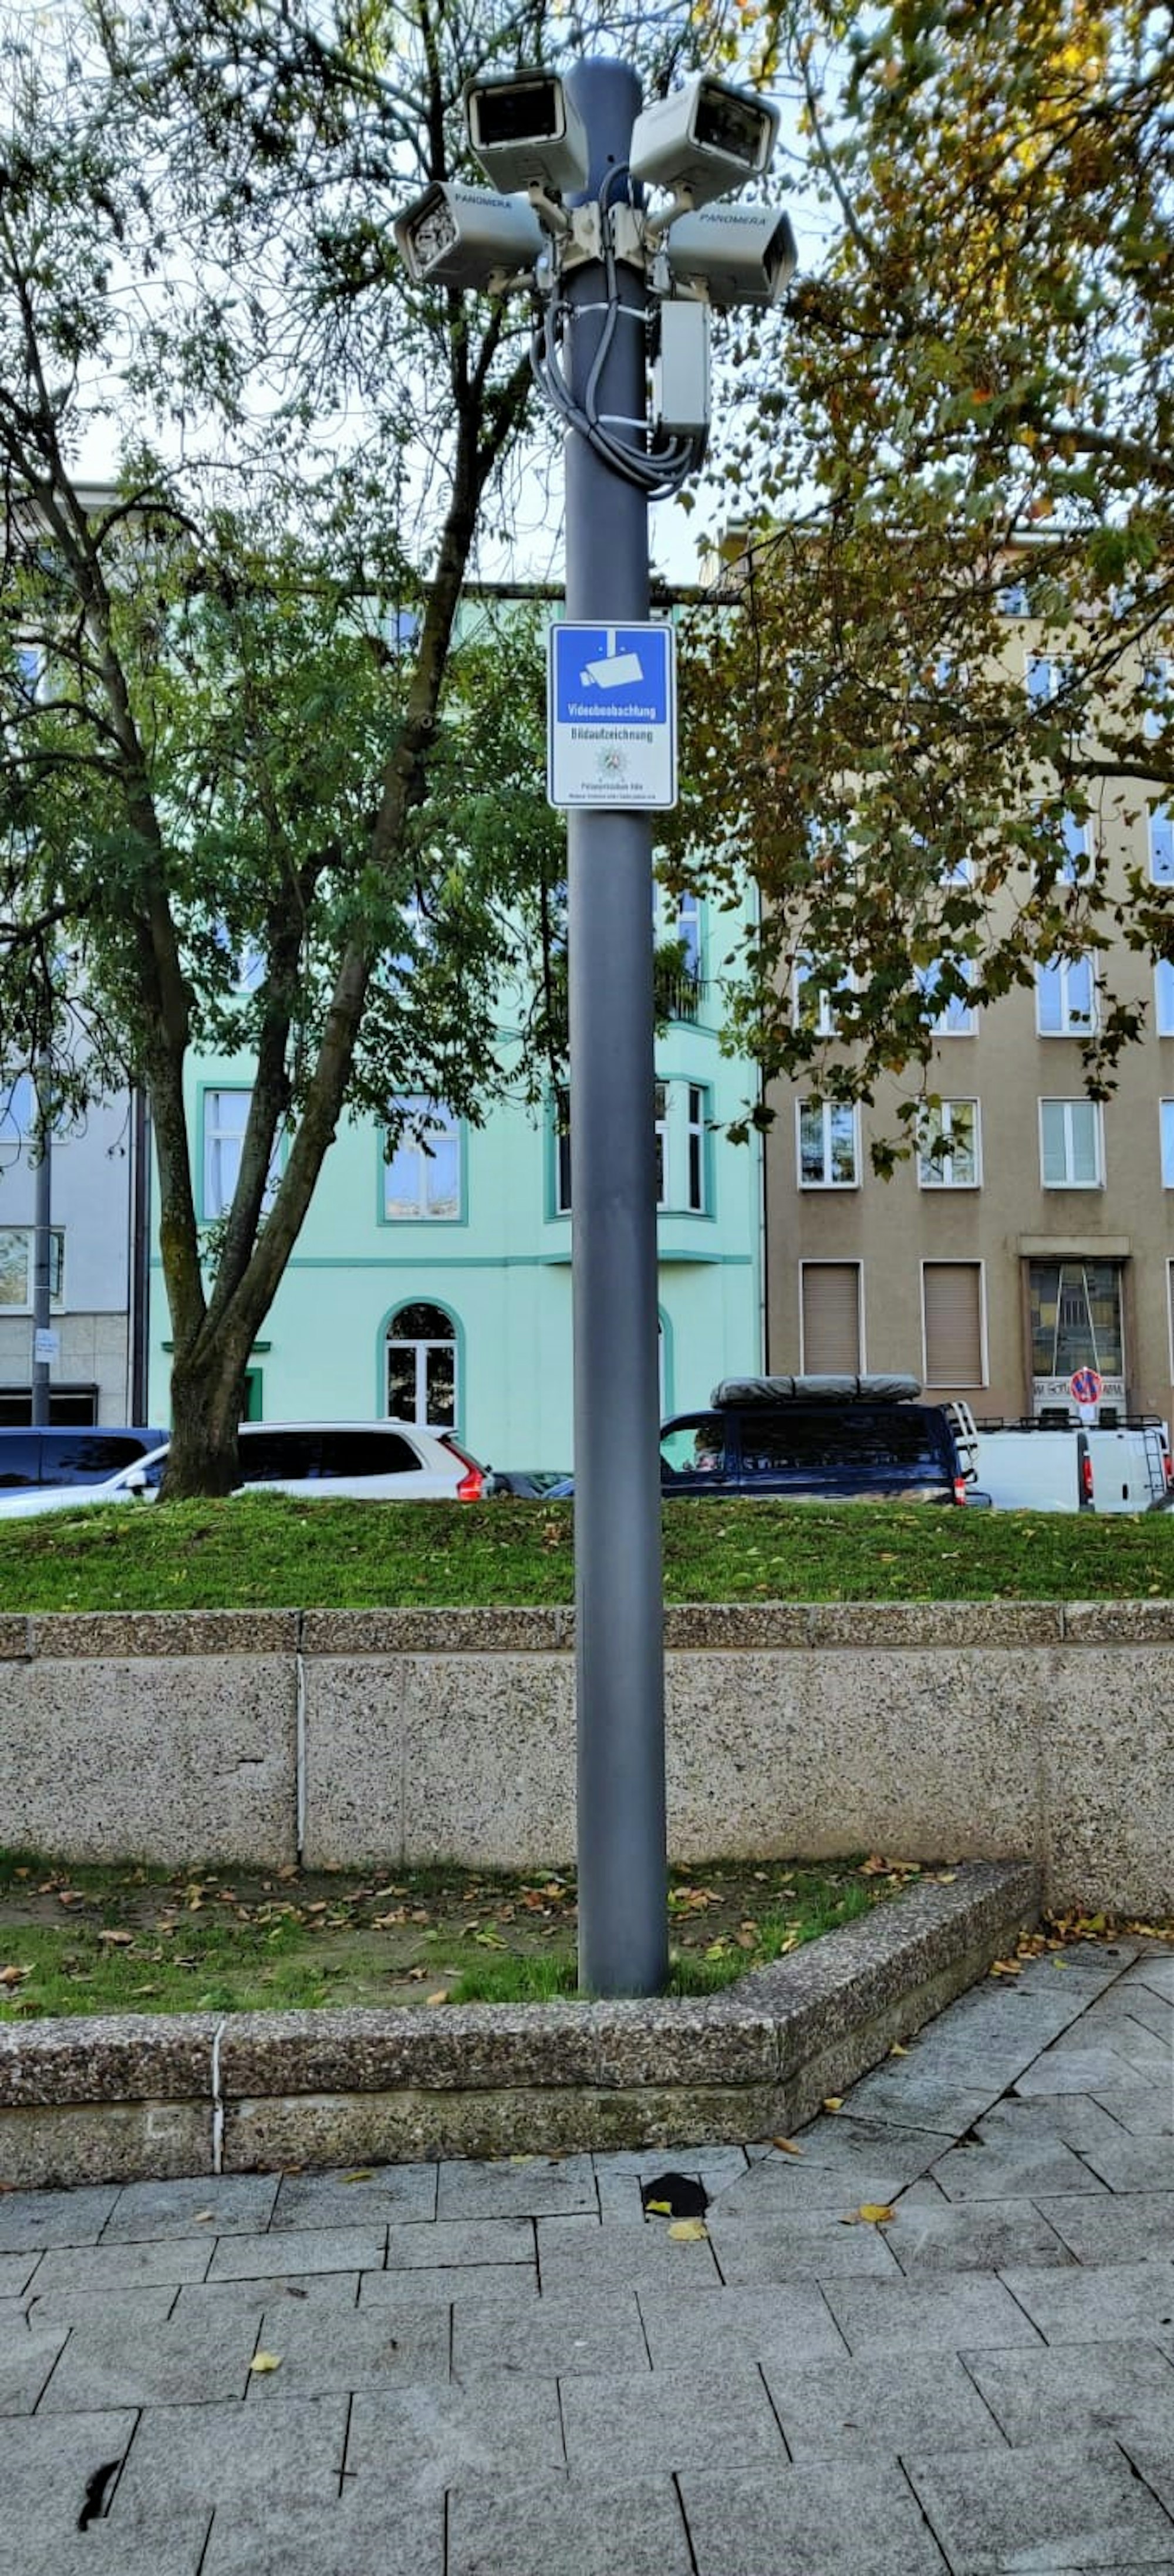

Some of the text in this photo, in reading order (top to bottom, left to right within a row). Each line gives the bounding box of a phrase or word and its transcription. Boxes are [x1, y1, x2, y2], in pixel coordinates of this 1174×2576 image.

[455, 193, 512, 208] PANOMERA
[700, 214, 765, 226] PANOMERA
[567, 702, 656, 720] Videobeobachtung
[571, 726, 653, 743] Bildaufzeichnung
